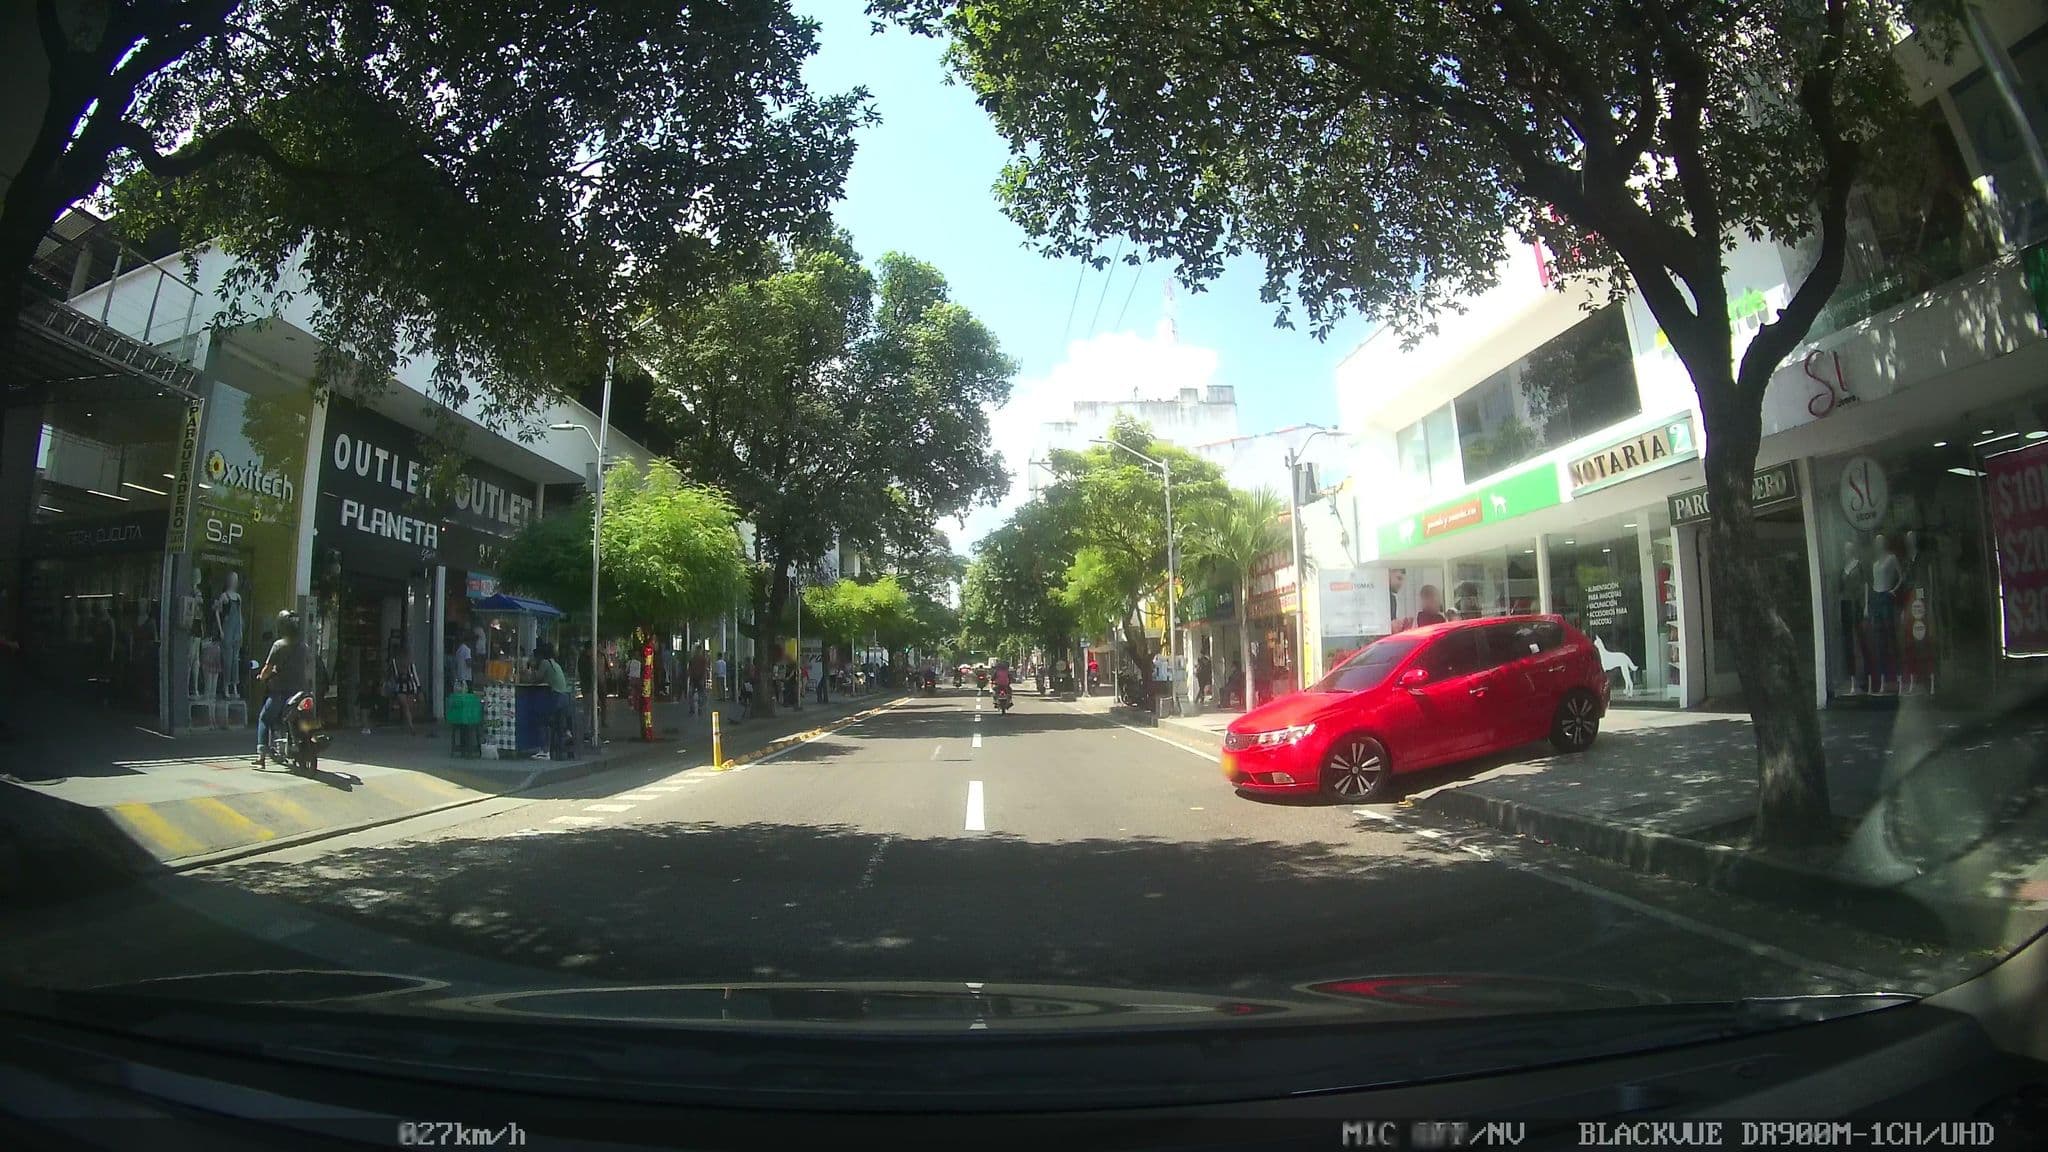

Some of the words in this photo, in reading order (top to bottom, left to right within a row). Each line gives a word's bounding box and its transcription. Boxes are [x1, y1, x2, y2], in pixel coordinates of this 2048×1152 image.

[1669, 424, 1688, 454] 2
[173, 406, 199, 528] PARQUEADERO
[340, 499, 438, 550] PLANETA
[455, 473, 532, 528] OUTLET
